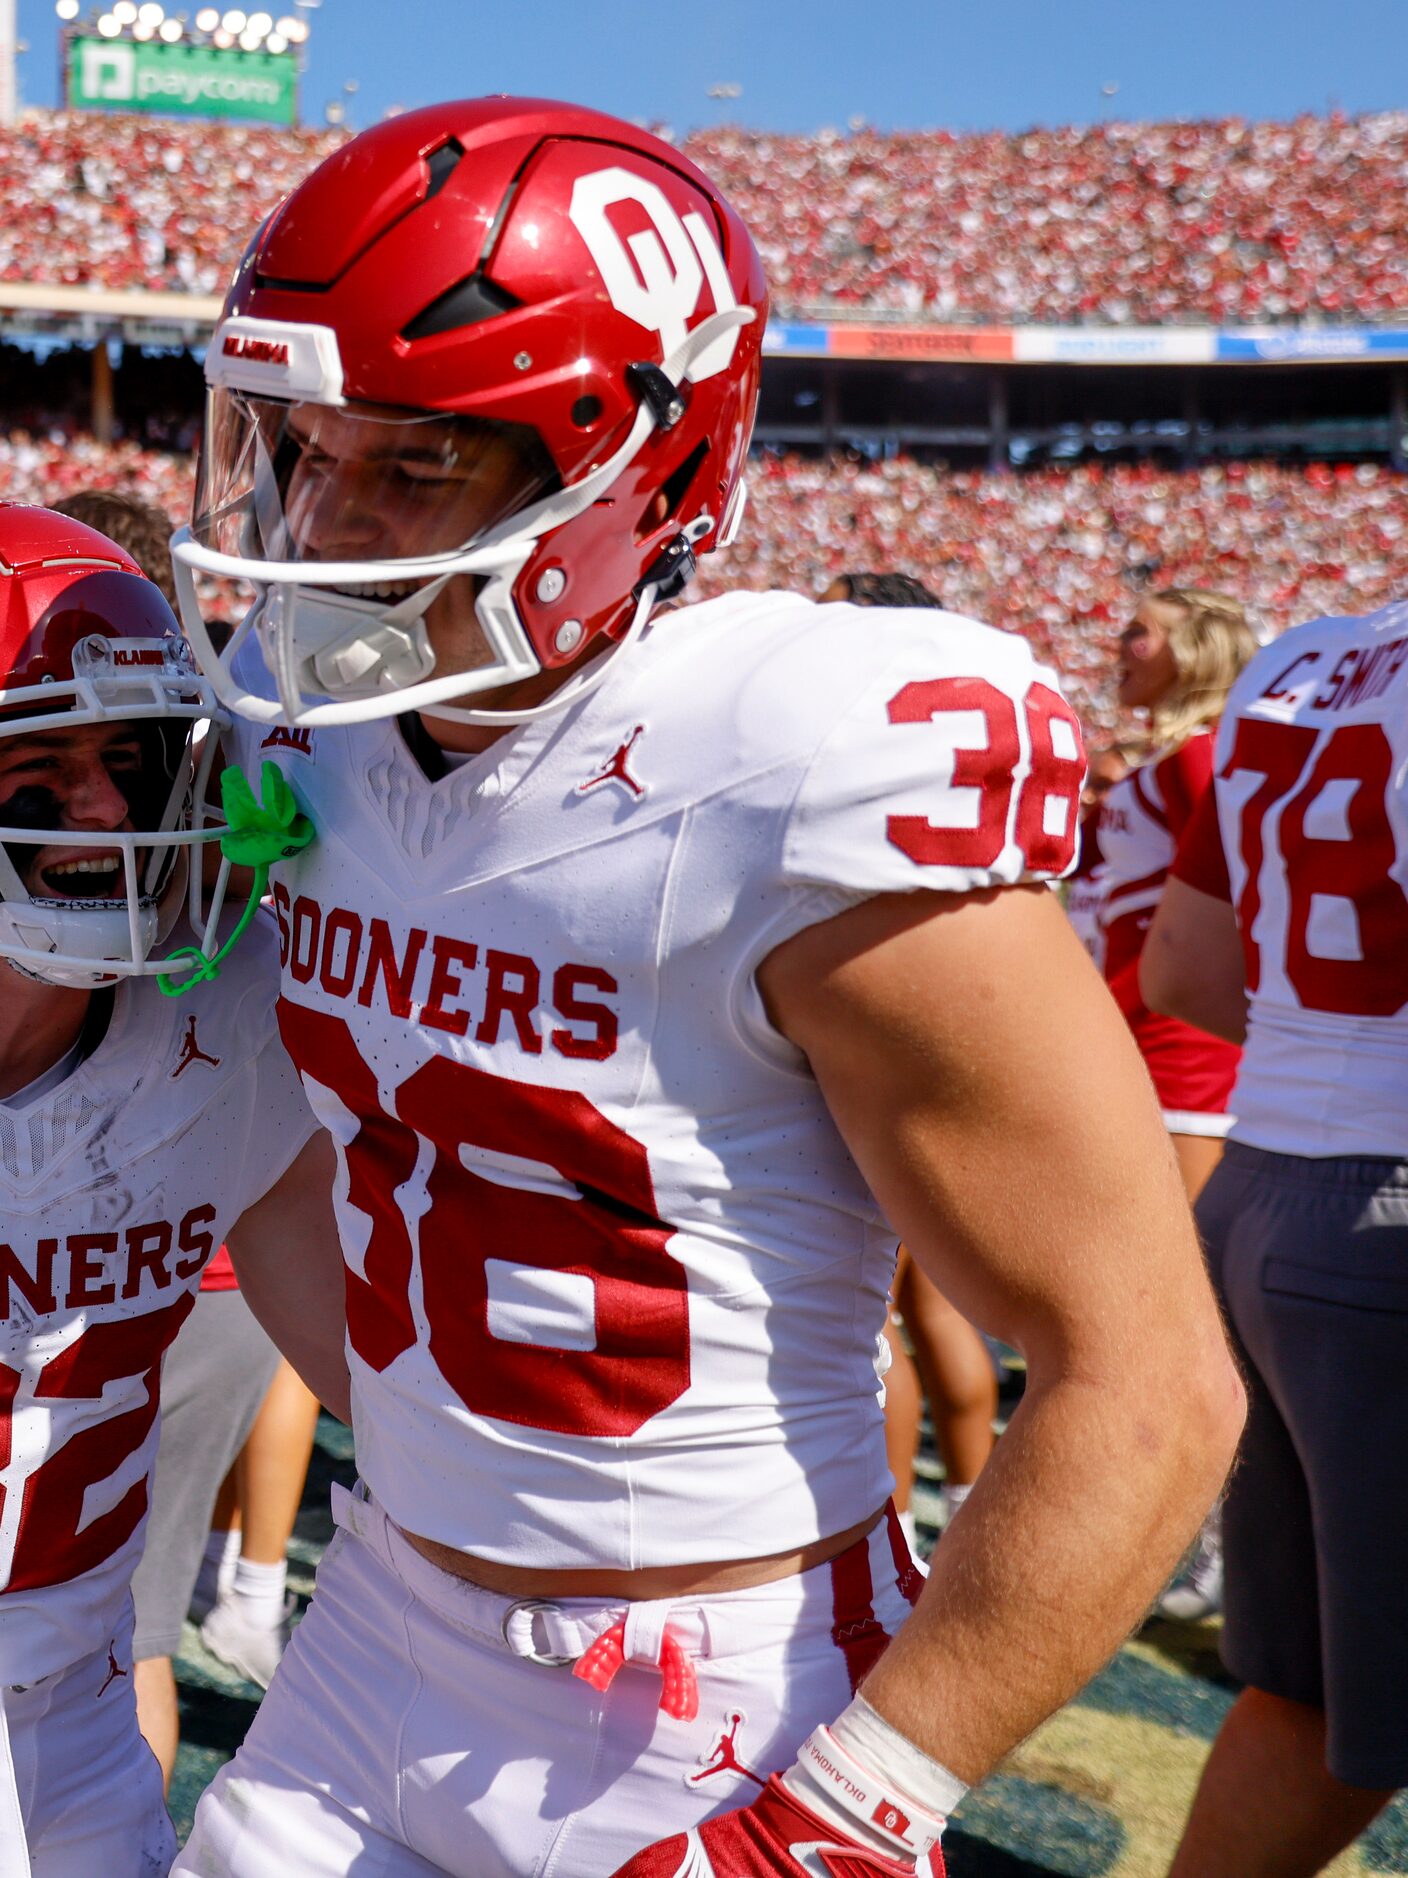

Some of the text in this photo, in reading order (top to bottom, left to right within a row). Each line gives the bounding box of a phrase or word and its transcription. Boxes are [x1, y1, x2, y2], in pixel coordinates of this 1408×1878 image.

[138, 69, 281, 104] paycom
[886, 676, 1088, 873] 38
[1222, 717, 1408, 1018] 78
[273, 881, 619, 1062] SOONERS
[276, 996, 691, 1437] 38
[809, 1746, 867, 1803] OKLAHOMA
